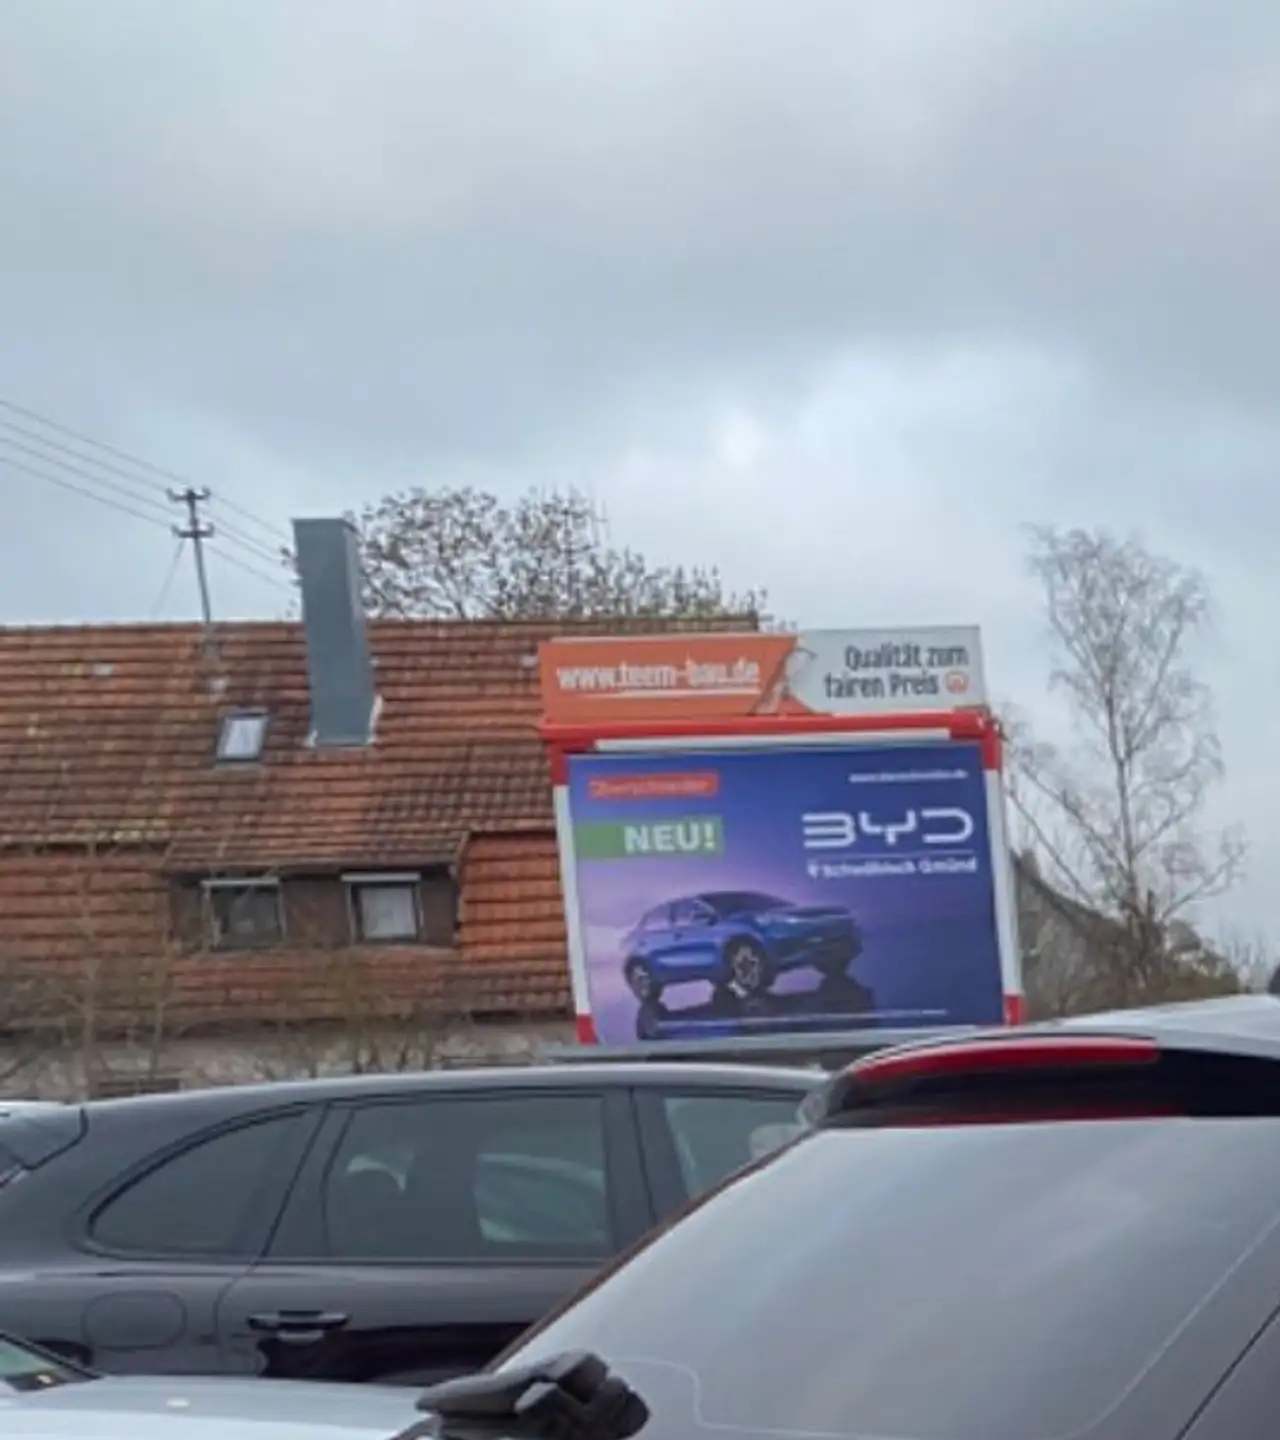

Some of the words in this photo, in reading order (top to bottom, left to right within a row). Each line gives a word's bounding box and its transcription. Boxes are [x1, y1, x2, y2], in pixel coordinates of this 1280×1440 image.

[845, 643, 922, 671] Qualität
[926, 646, 969, 668] zum
[889, 671, 939, 697] Preis
[624, 821, 715, 854] NEU!
[802, 808, 974, 848] BYD
